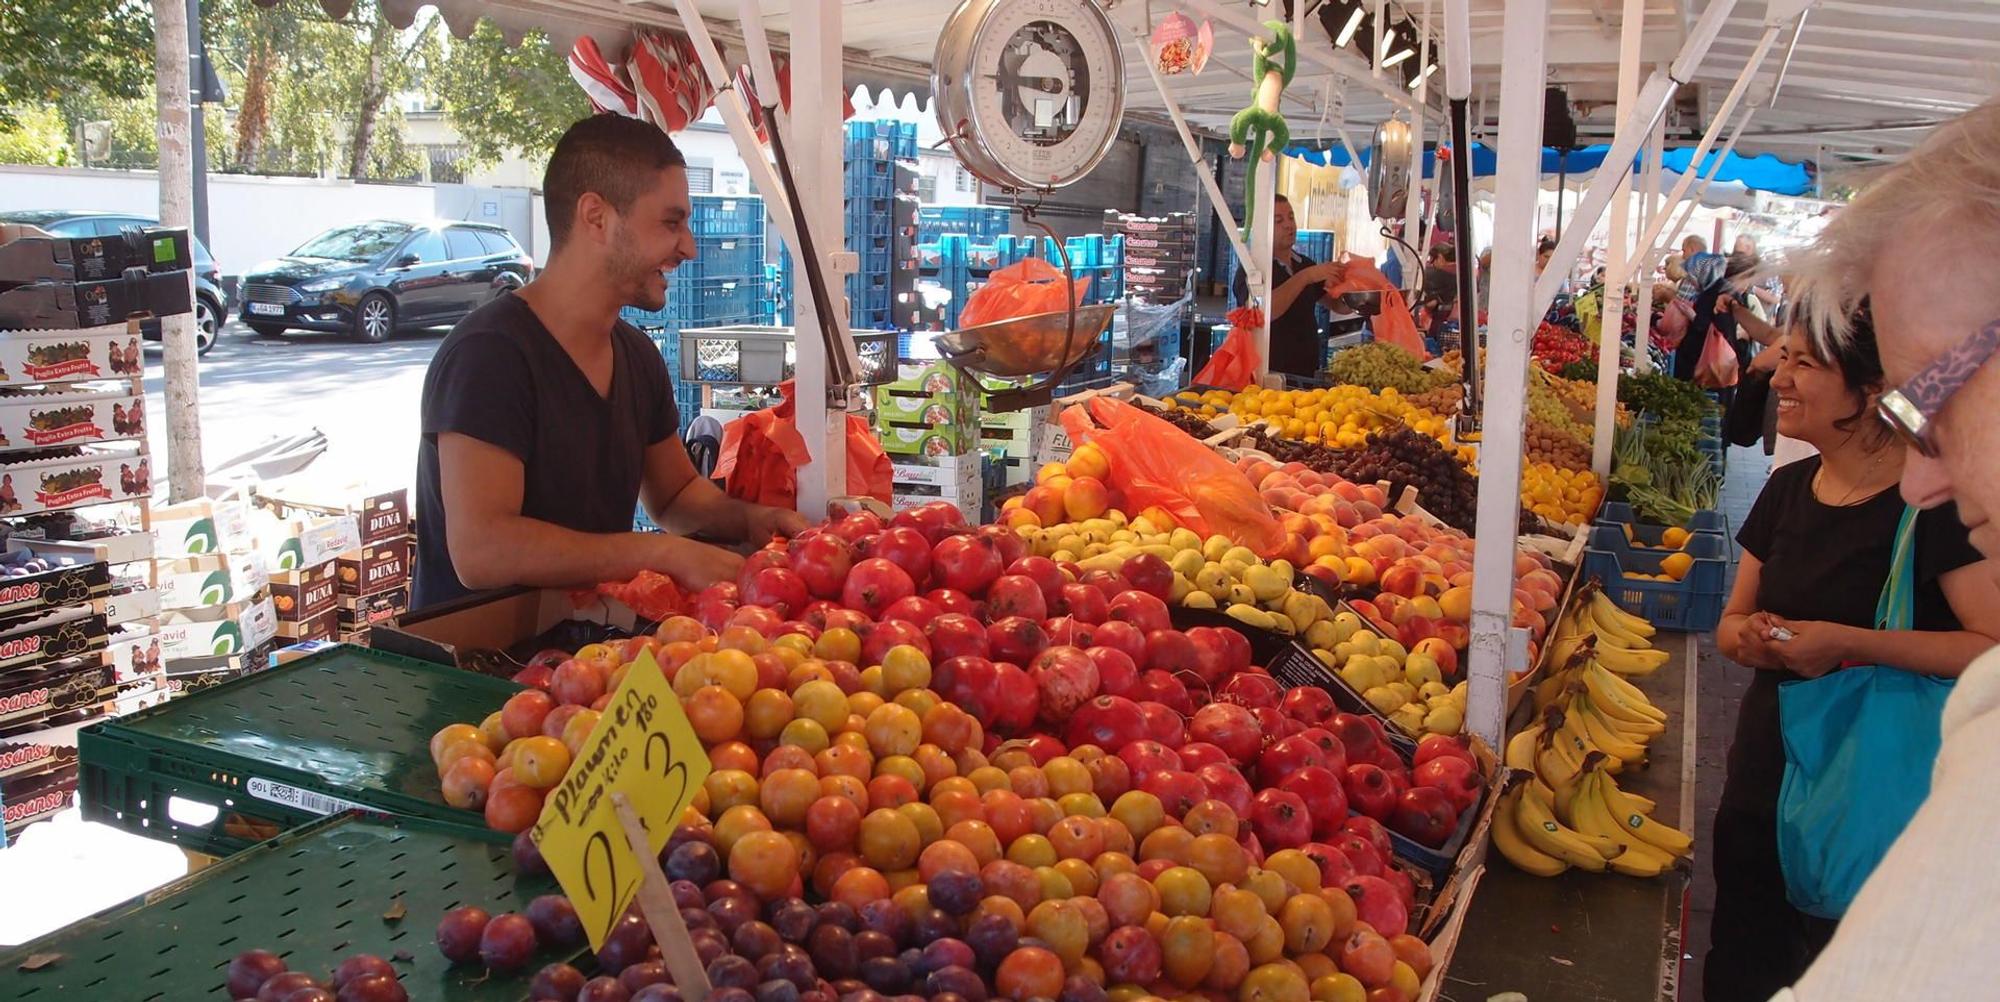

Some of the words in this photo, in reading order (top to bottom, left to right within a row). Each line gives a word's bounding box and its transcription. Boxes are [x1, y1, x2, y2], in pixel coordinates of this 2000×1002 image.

[57, 430, 73, 439] Extra
[74, 425, 93, 435] Frutta
[47, 496, 66, 506] Puglia
[67, 492, 82, 500] Extra
[83, 487, 101, 497] Frutta
[370, 512, 401, 532] DUNA
[369, 560, 401, 581] DUNA
[0, 581, 40, 605] anse
[305, 583, 333, 606] DUNA
[163, 629, 186, 641] avid
[0, 635, 40, 658] anse
[0, 687, 48, 714] sanse
[0, 743, 50, 770] osanse
[251, 781, 267, 792] 106
